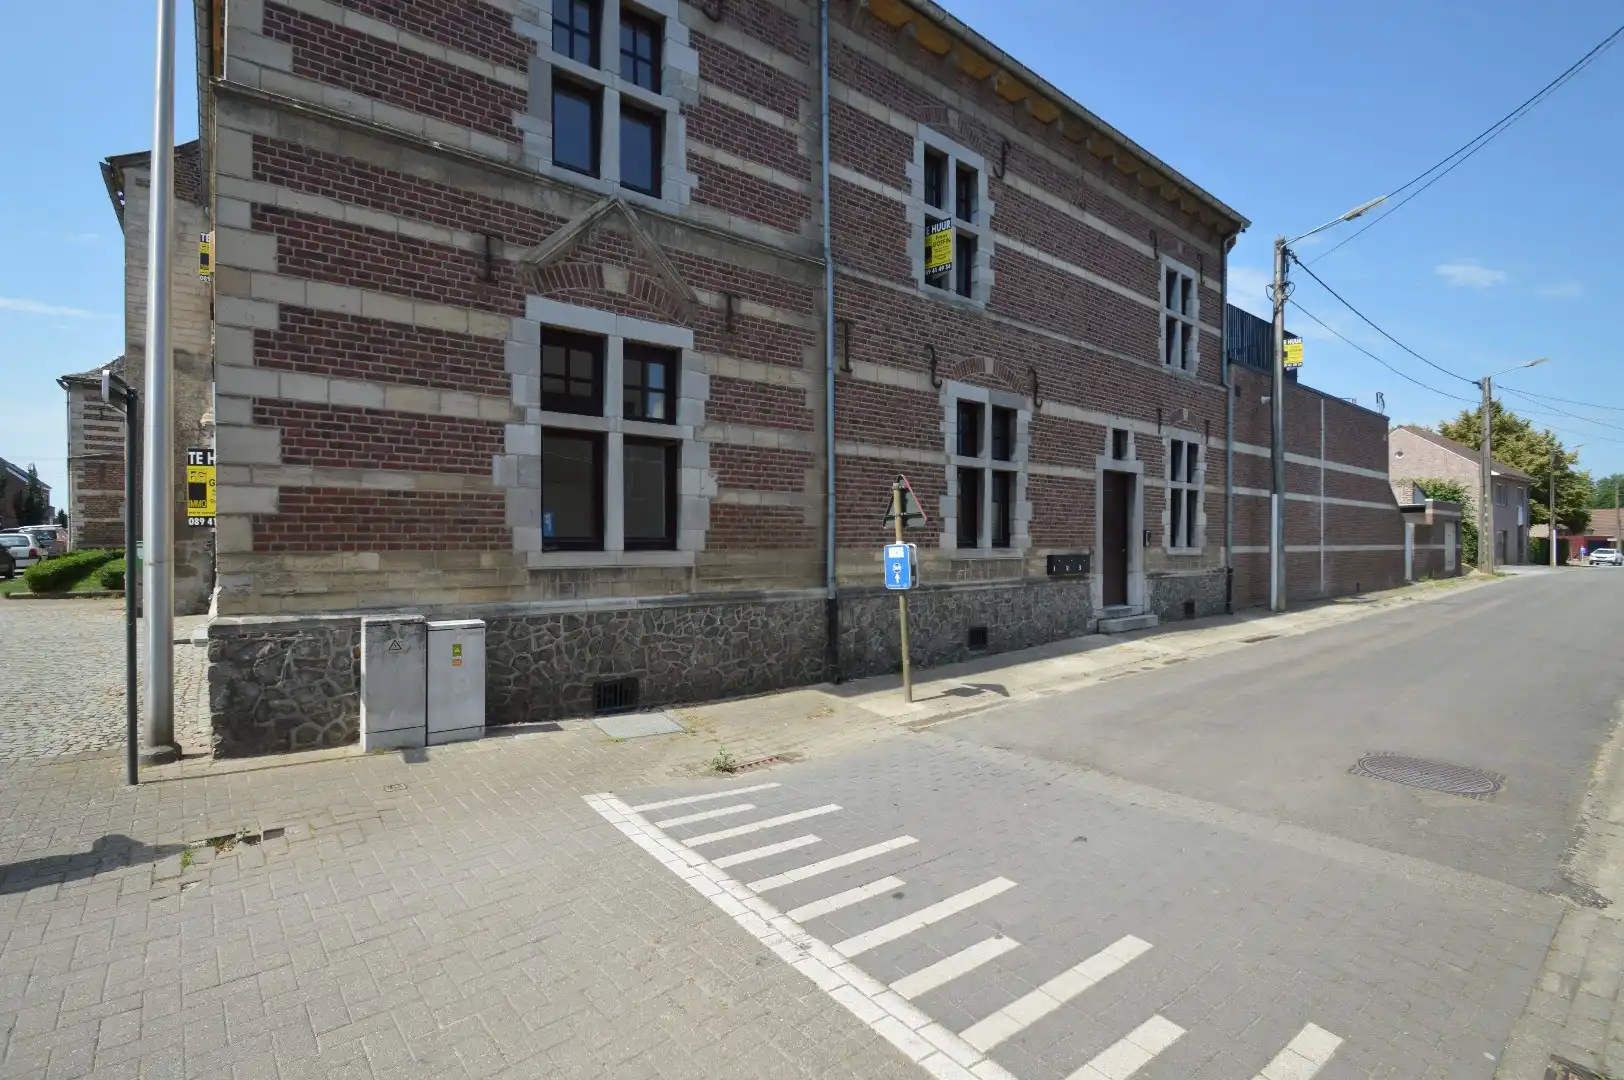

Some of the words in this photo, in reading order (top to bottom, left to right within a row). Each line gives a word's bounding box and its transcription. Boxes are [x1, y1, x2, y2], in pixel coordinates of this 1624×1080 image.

[932, 219, 951, 233] HUUR
[188, 451, 203, 465] TE
[188, 517, 205, 526] 089
